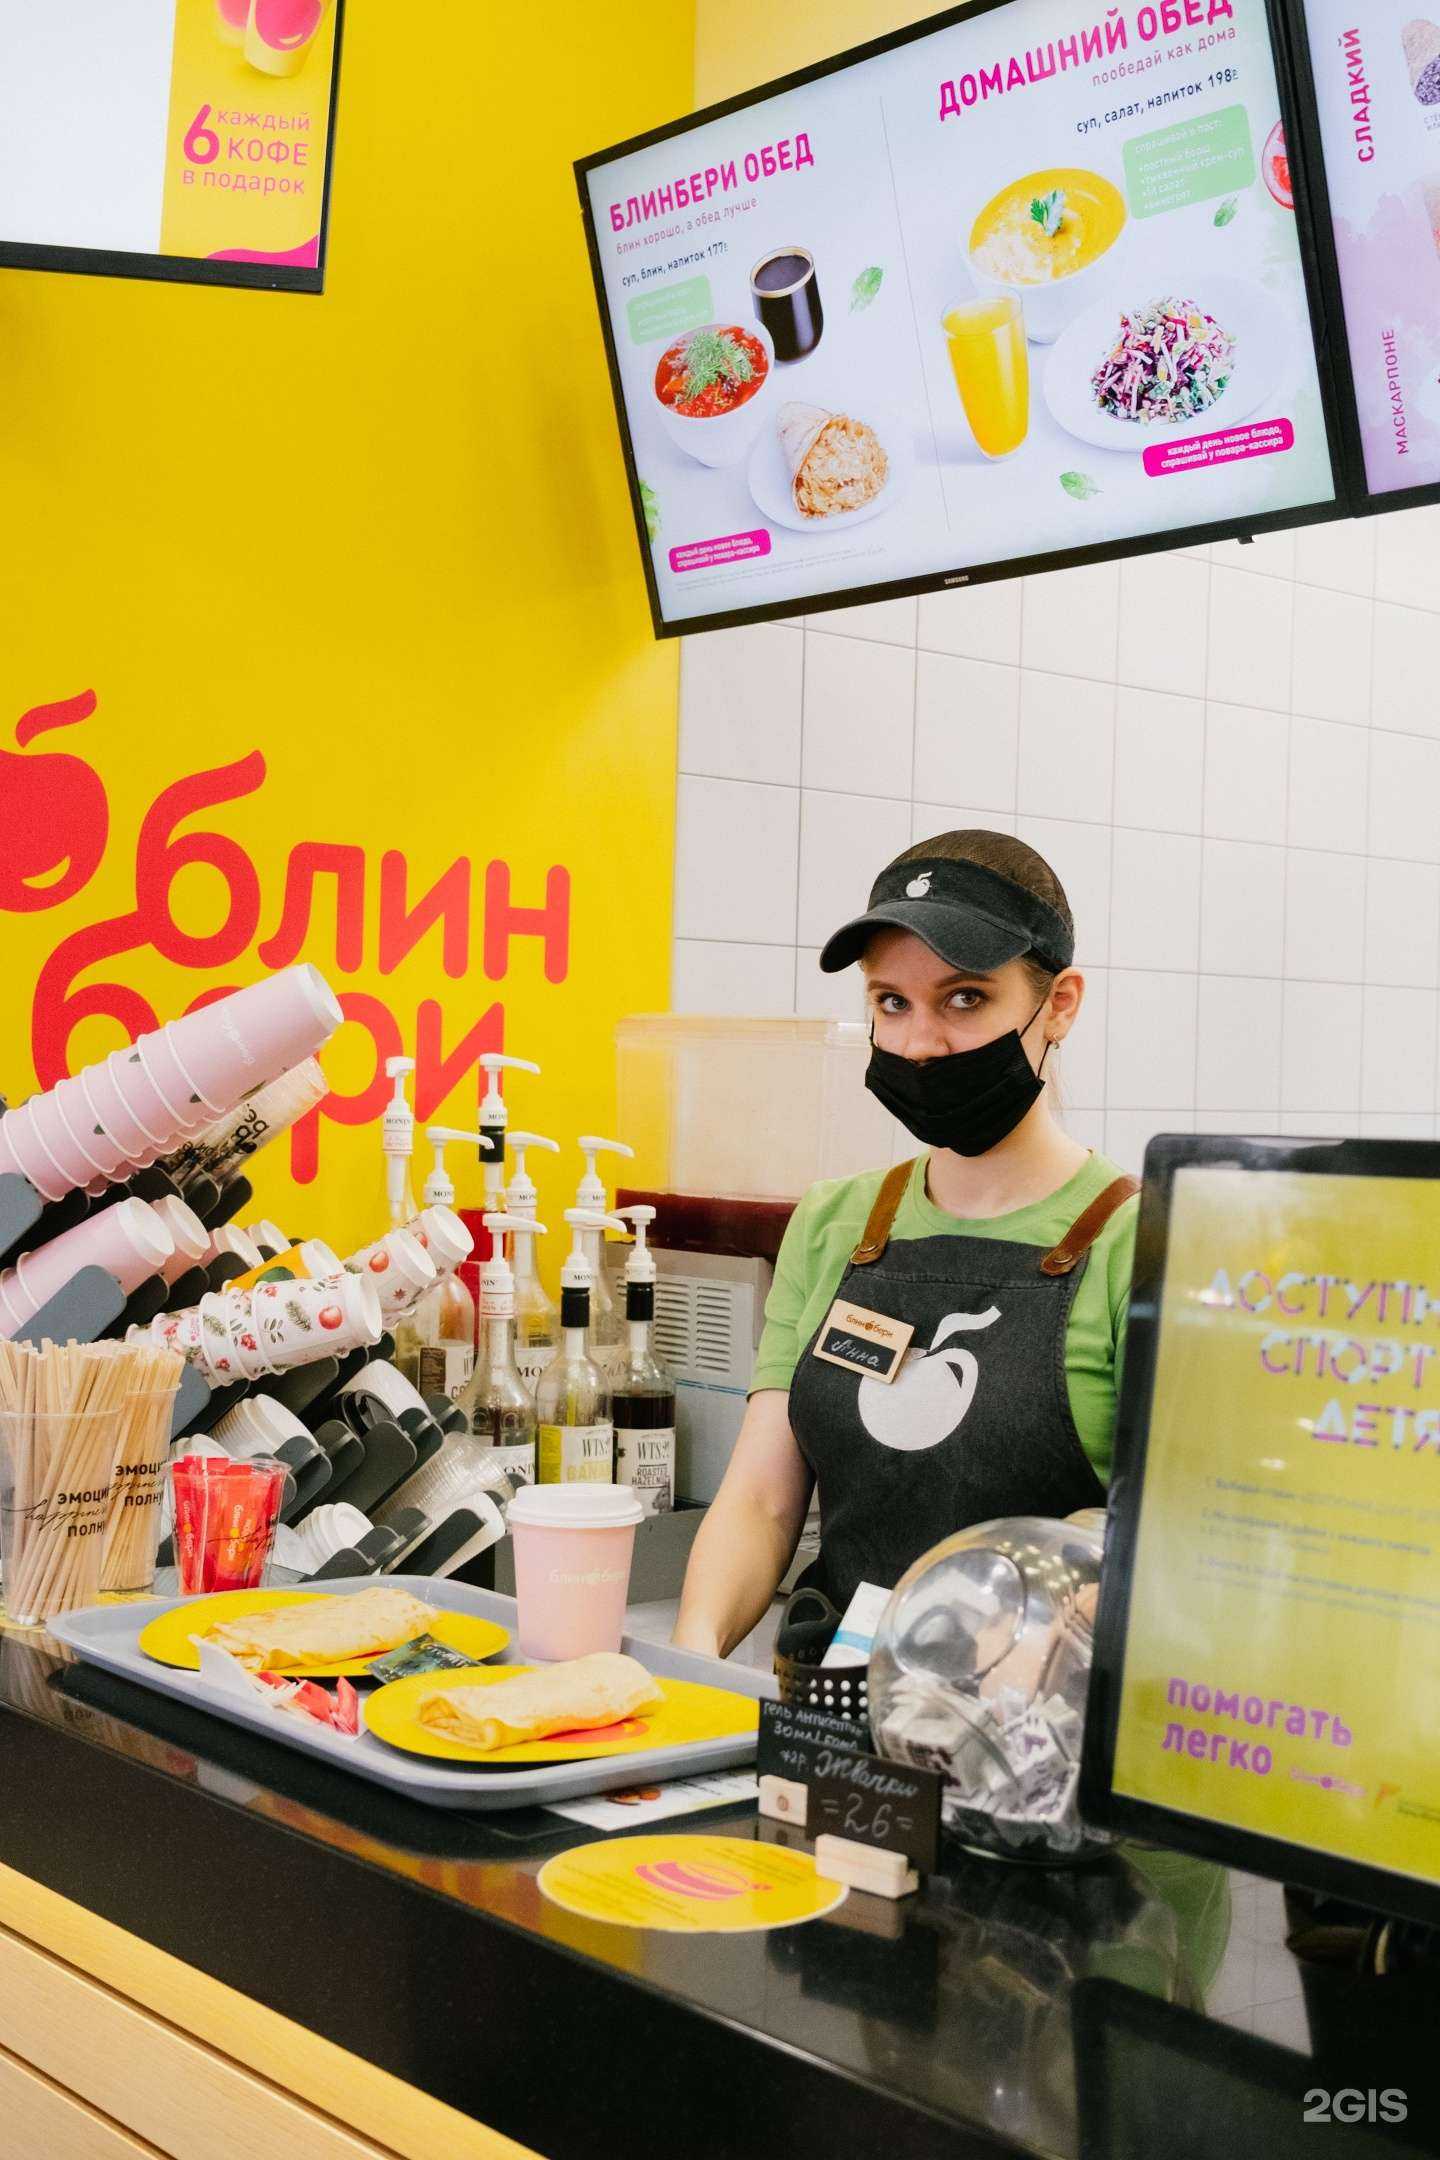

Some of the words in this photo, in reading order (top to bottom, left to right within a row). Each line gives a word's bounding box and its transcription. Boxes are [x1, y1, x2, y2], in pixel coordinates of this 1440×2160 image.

[939, 8, 1128, 121] ДОМАШНИЙ
[1137, 0, 1234, 41] ОБЕД
[1092, 51, 1163, 86] пообедай
[1167, 42, 1193, 61] как
[1198, 26, 1236, 52] дома
[1076, 117, 1101, 134] суп,
[1104, 102, 1144, 124] салат,
[1147, 81, 1203, 110] напиток
[1338, 29, 1375, 163] СЛАДКИЙ
[183, 104, 220, 165] 6
[217, 108, 311, 131] каждый
[228, 137, 309, 166] КОФЕ
[183, 169, 194, 185] в
[203, 171, 305, 197] подарок
[609, 160, 738, 232] БЛИНБЕРИ
[744, 133, 815, 183] ОБЕД
[616, 241, 641, 255] блин
[644, 225, 684, 245] хорошо,
[696, 211, 721, 227] обед
[723, 198, 757, 218] лучше
[667, 250, 705, 270] напиток
[1382, 329, 1409, 455] МАСКАРПОНЕ
[136, 750, 571, 984] блин
[31, 908, 505, 1184] бри
[1261, 1331, 1437, 1390] СПОРТ
[1167, 1677, 1352, 1747] помогать
[1162, 1722, 1273, 1776] легко
